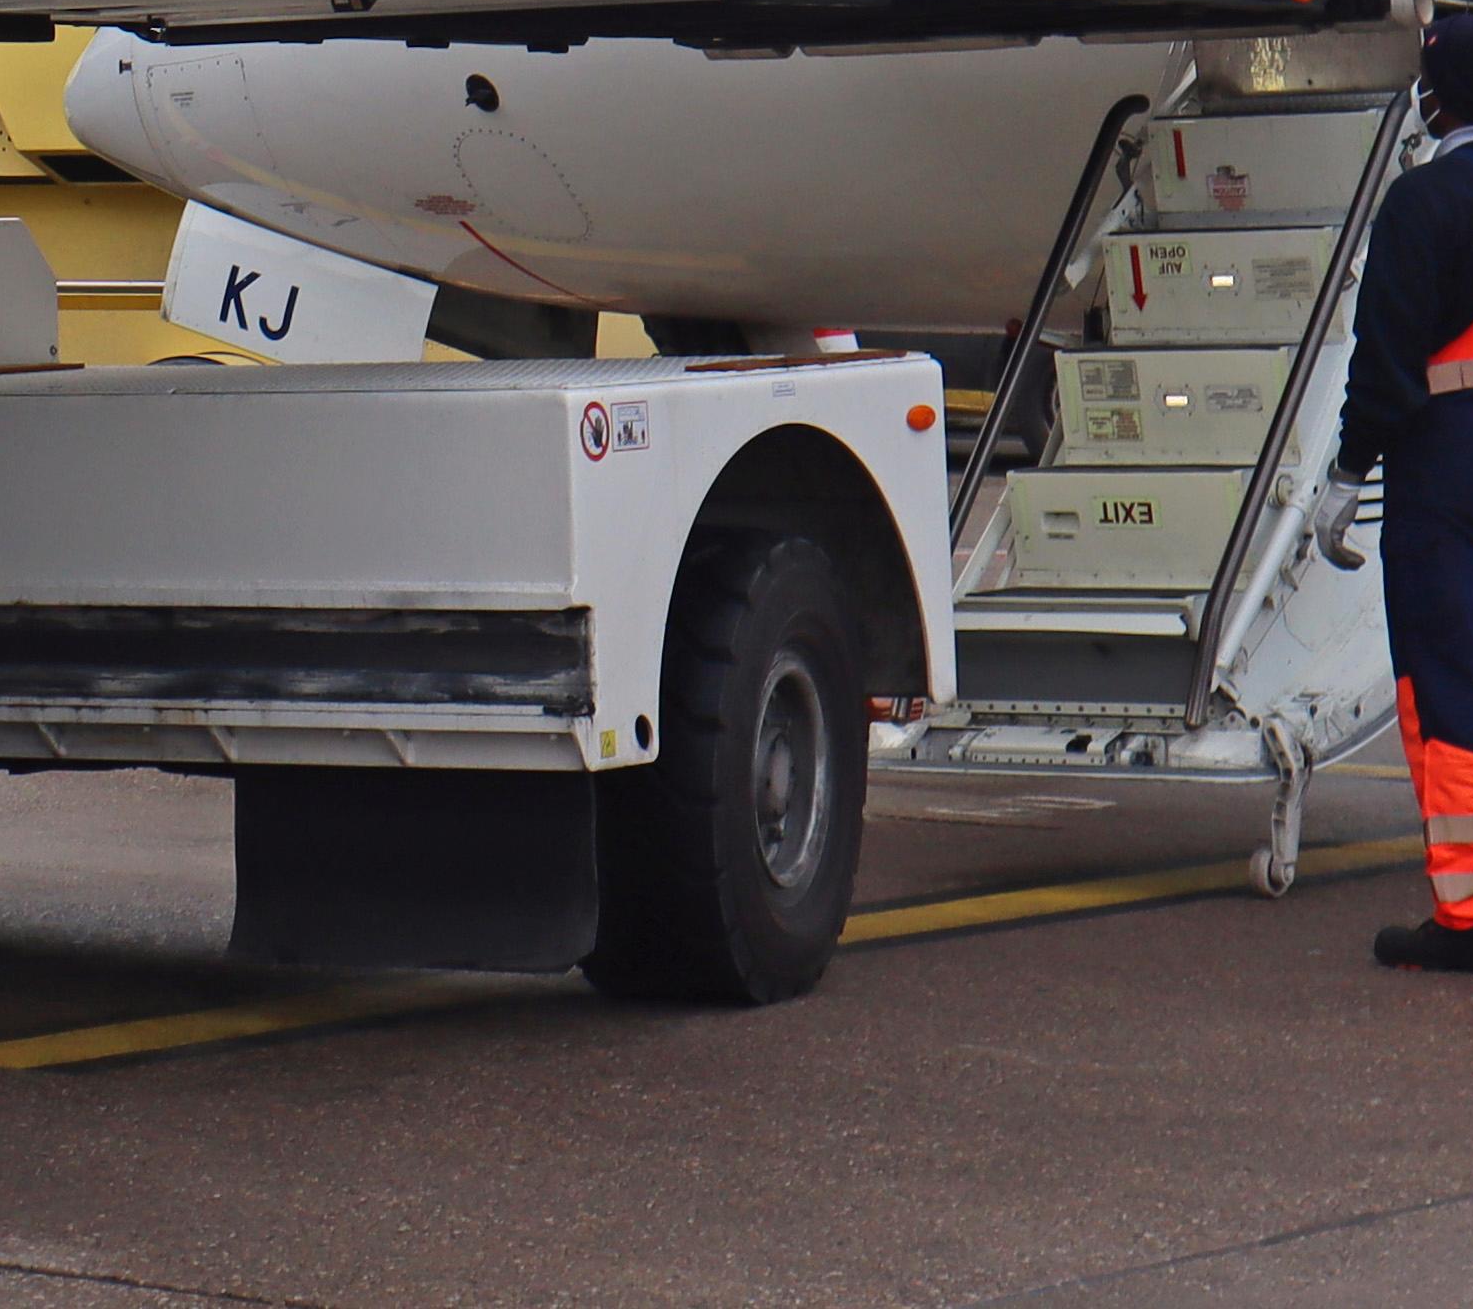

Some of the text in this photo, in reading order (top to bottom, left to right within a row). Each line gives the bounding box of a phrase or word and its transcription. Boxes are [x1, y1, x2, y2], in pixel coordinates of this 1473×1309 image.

[1149, 246, 1187, 259] OPEN
[1157, 262, 1183, 275] AUF
[219, 264, 300, 341] KJ
[1099, 501, 1154, 525] EXIT
